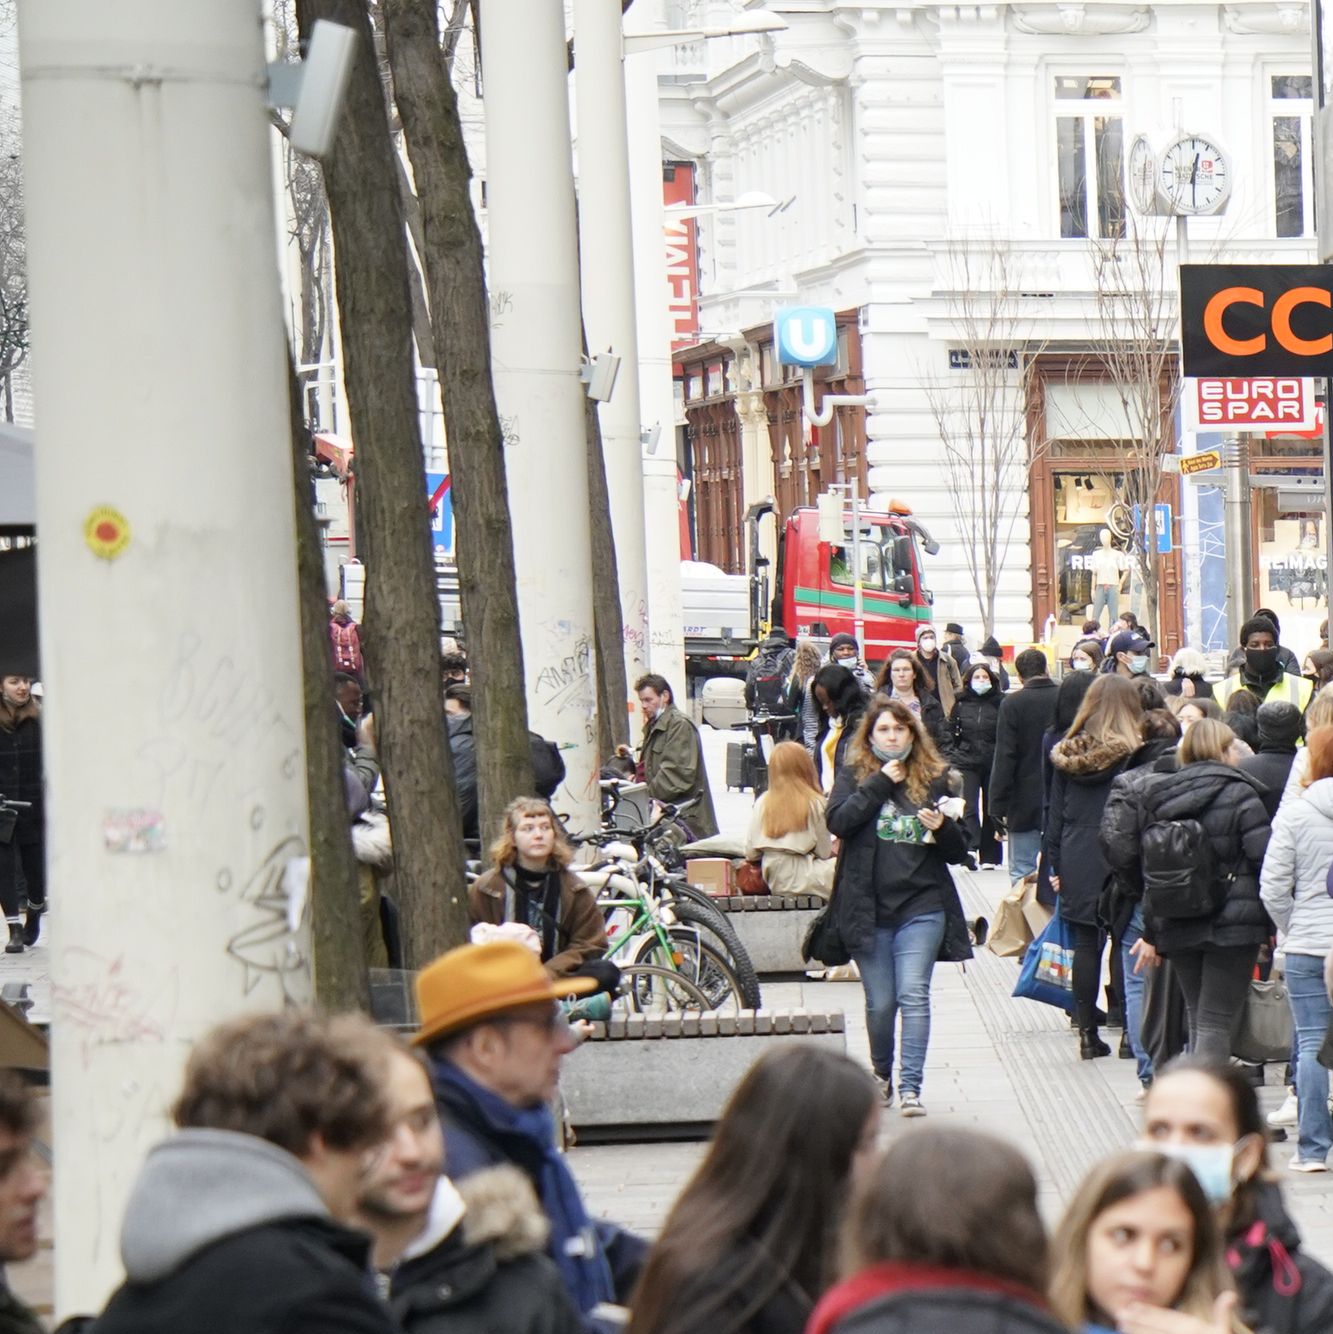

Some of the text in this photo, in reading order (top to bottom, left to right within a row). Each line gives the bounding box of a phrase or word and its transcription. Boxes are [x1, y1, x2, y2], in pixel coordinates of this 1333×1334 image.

[788, 318, 826, 358] U
[1201, 380, 1299, 400] EURO
[1201, 401, 1300, 420] SPAR
